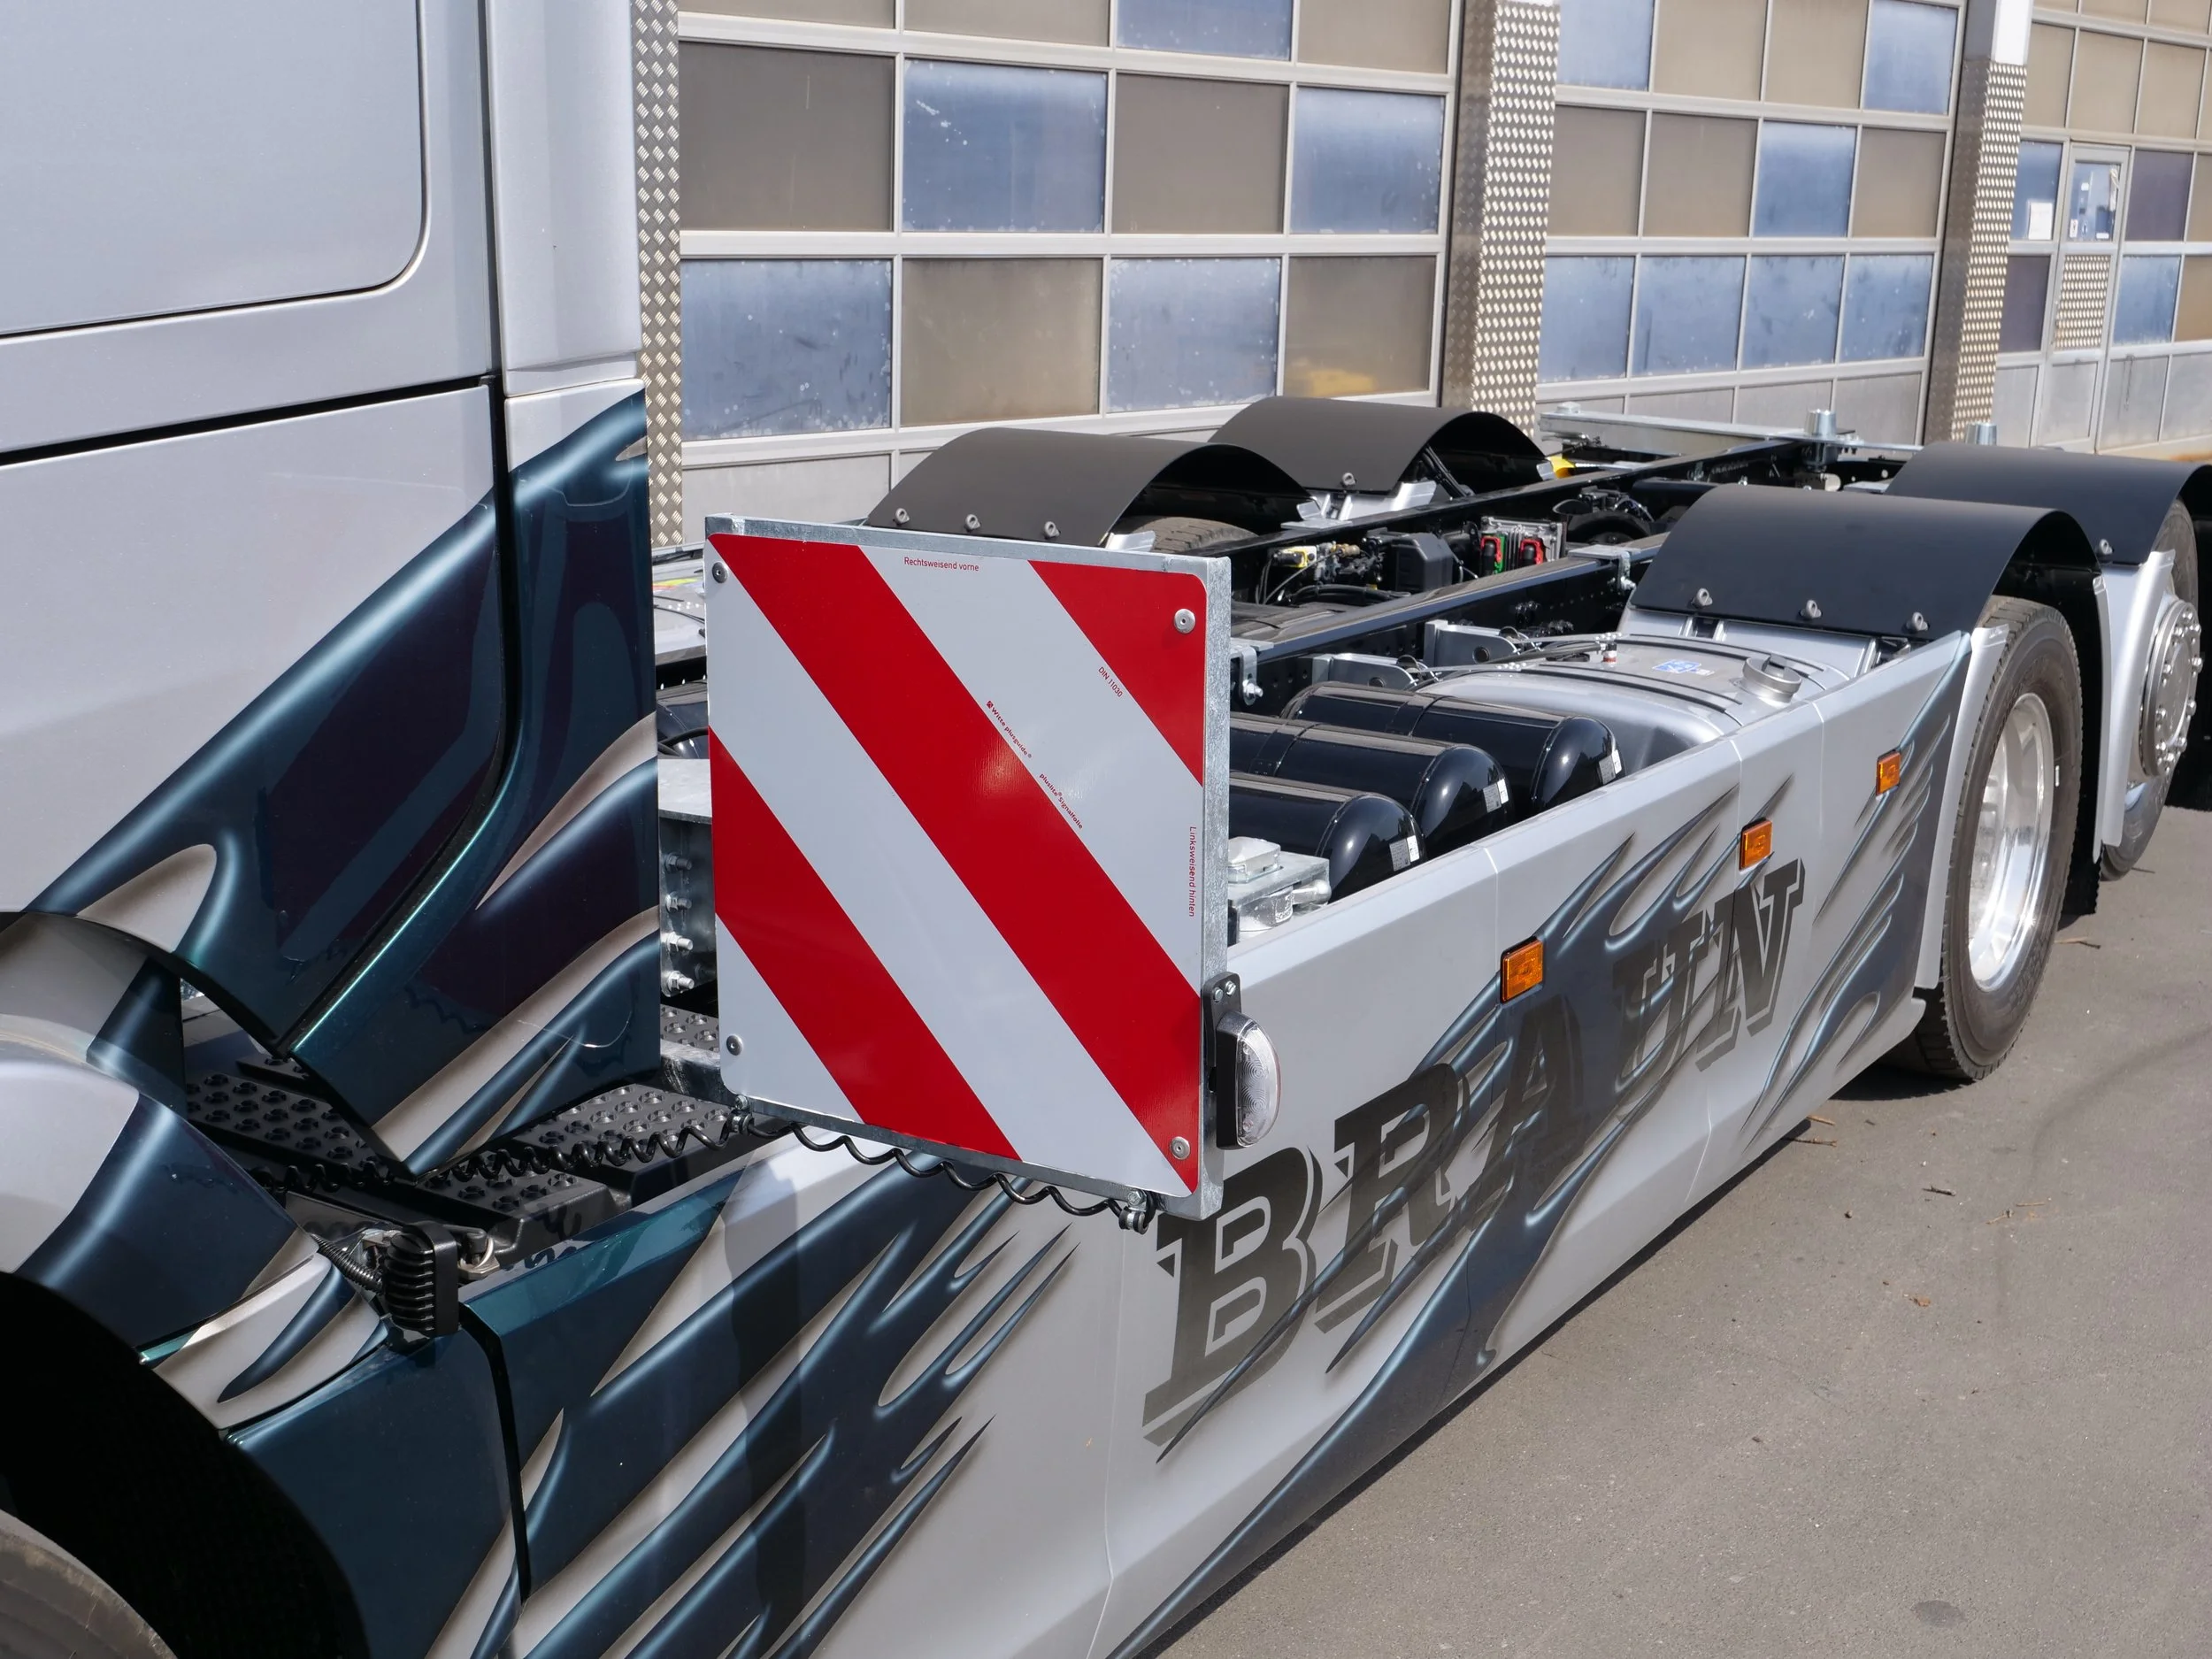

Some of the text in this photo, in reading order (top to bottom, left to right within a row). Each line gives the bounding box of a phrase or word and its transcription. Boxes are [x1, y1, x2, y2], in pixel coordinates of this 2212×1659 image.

[903, 557, 957, 570] Rechtsweisend
[1098, 666, 1124, 697] DIN 11030
[992, 707, 1006, 726] Witte
[1057, 796, 1083, 829] Signalfolie
[1188, 826, 1197, 918] Linksweisend hinten
[1142, 858, 1805, 1448] BRAUN
